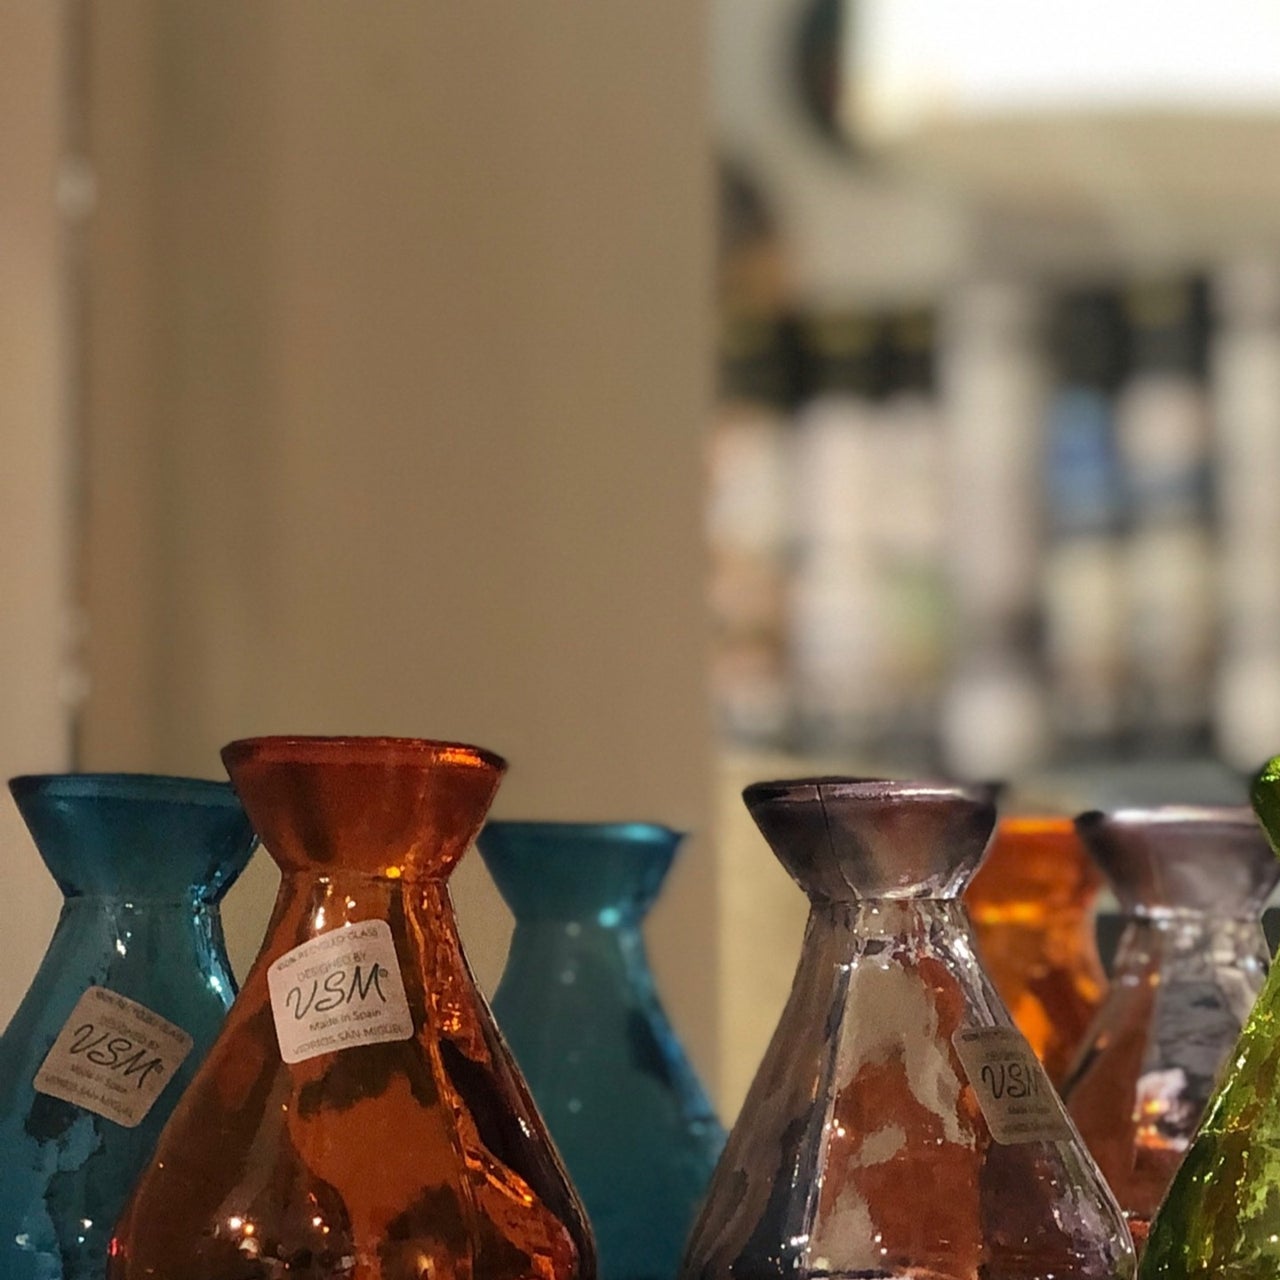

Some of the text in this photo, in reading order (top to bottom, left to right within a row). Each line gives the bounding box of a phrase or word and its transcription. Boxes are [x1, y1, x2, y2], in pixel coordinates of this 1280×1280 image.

[286, 962, 387, 1020] VSM
[309, 1009, 382, 1032] Made in Spain
[338, 1029, 361, 1041] SAN
[70, 1023, 162, 1089] VSM
